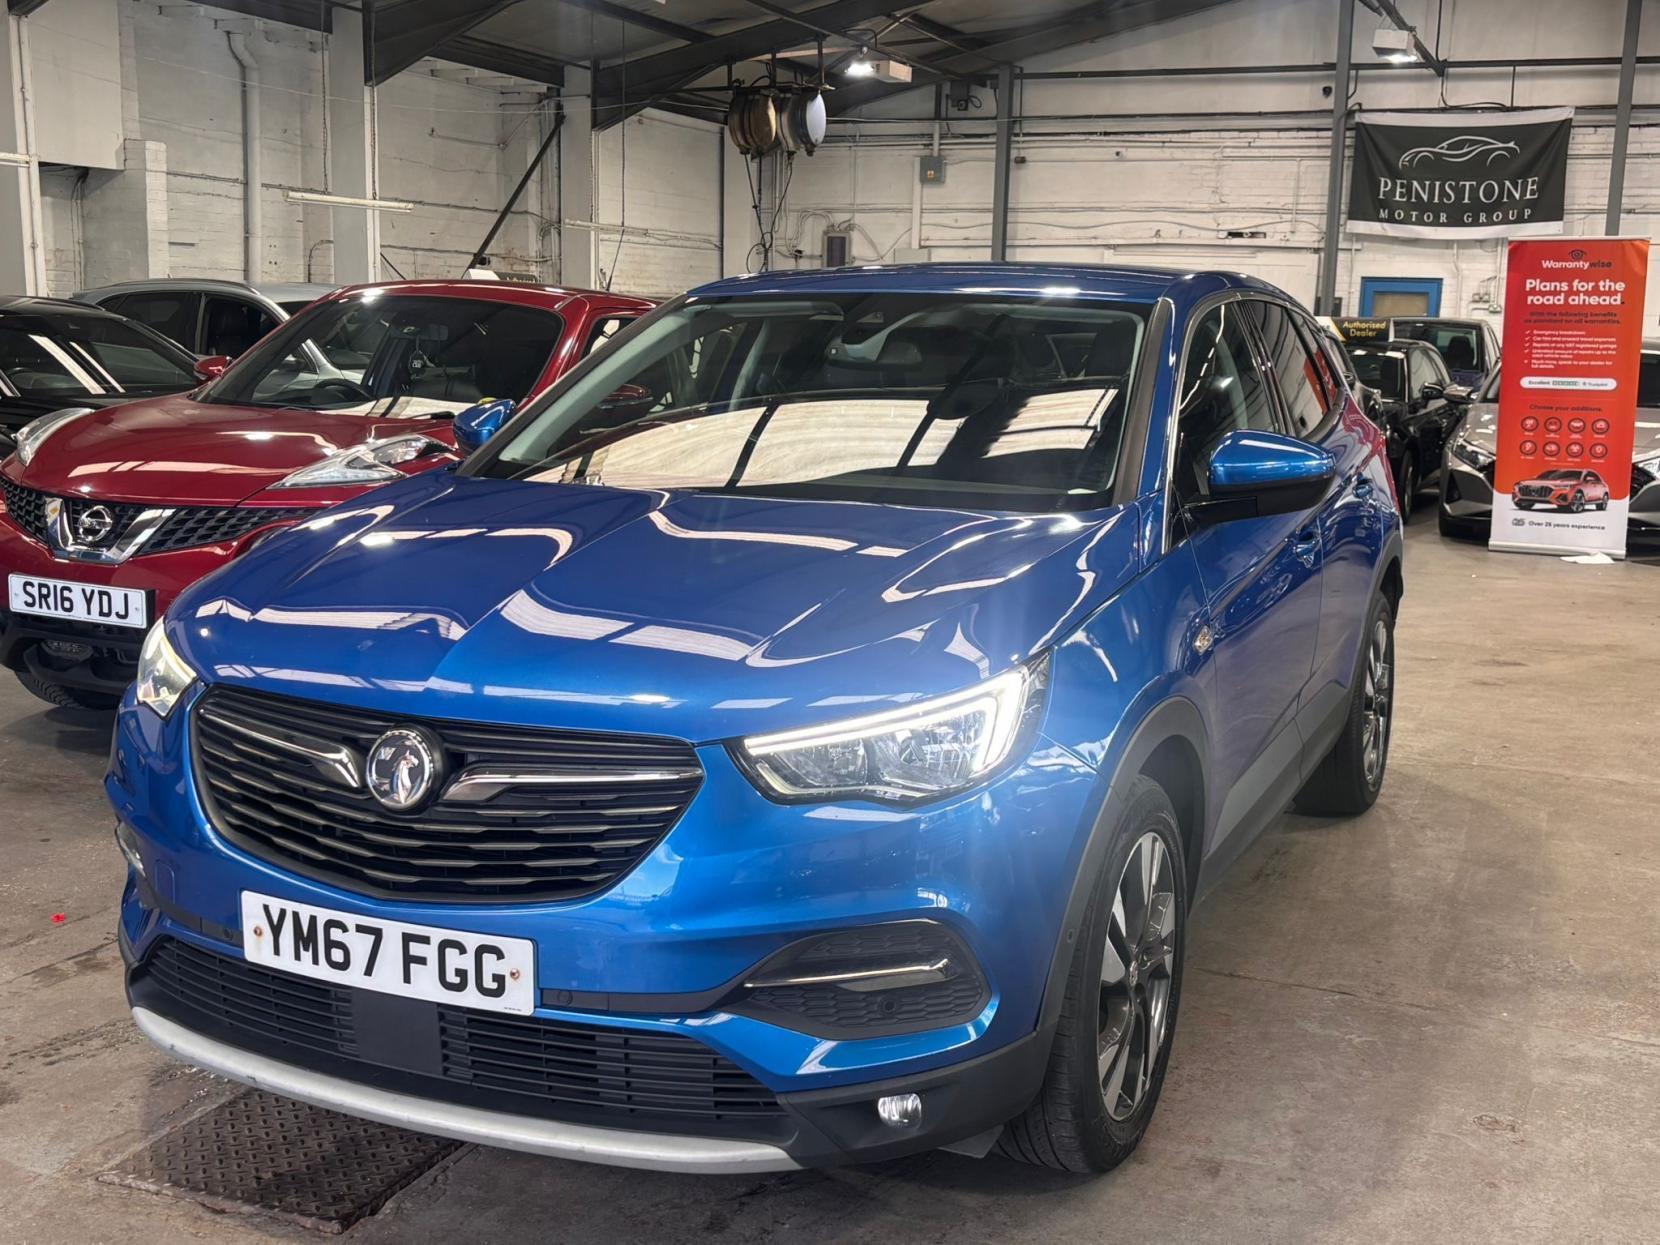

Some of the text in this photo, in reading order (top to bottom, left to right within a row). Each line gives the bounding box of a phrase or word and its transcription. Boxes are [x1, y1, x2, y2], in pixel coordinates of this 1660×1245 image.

[1378, 176, 1539, 204] PENISTONE
[1379, 208, 1532, 224] MOTOR GROUP
[1542, 260, 1612, 270] Warrantywise
[1525, 279, 1625, 292] Plans for the
[1527, 292, 1625, 305] road ahead.
[1343, 320, 1386, 329] Authorised
[23, 581, 129, 619] SR16 YDJ
[263, 904, 506, 999] YM67 FGG
